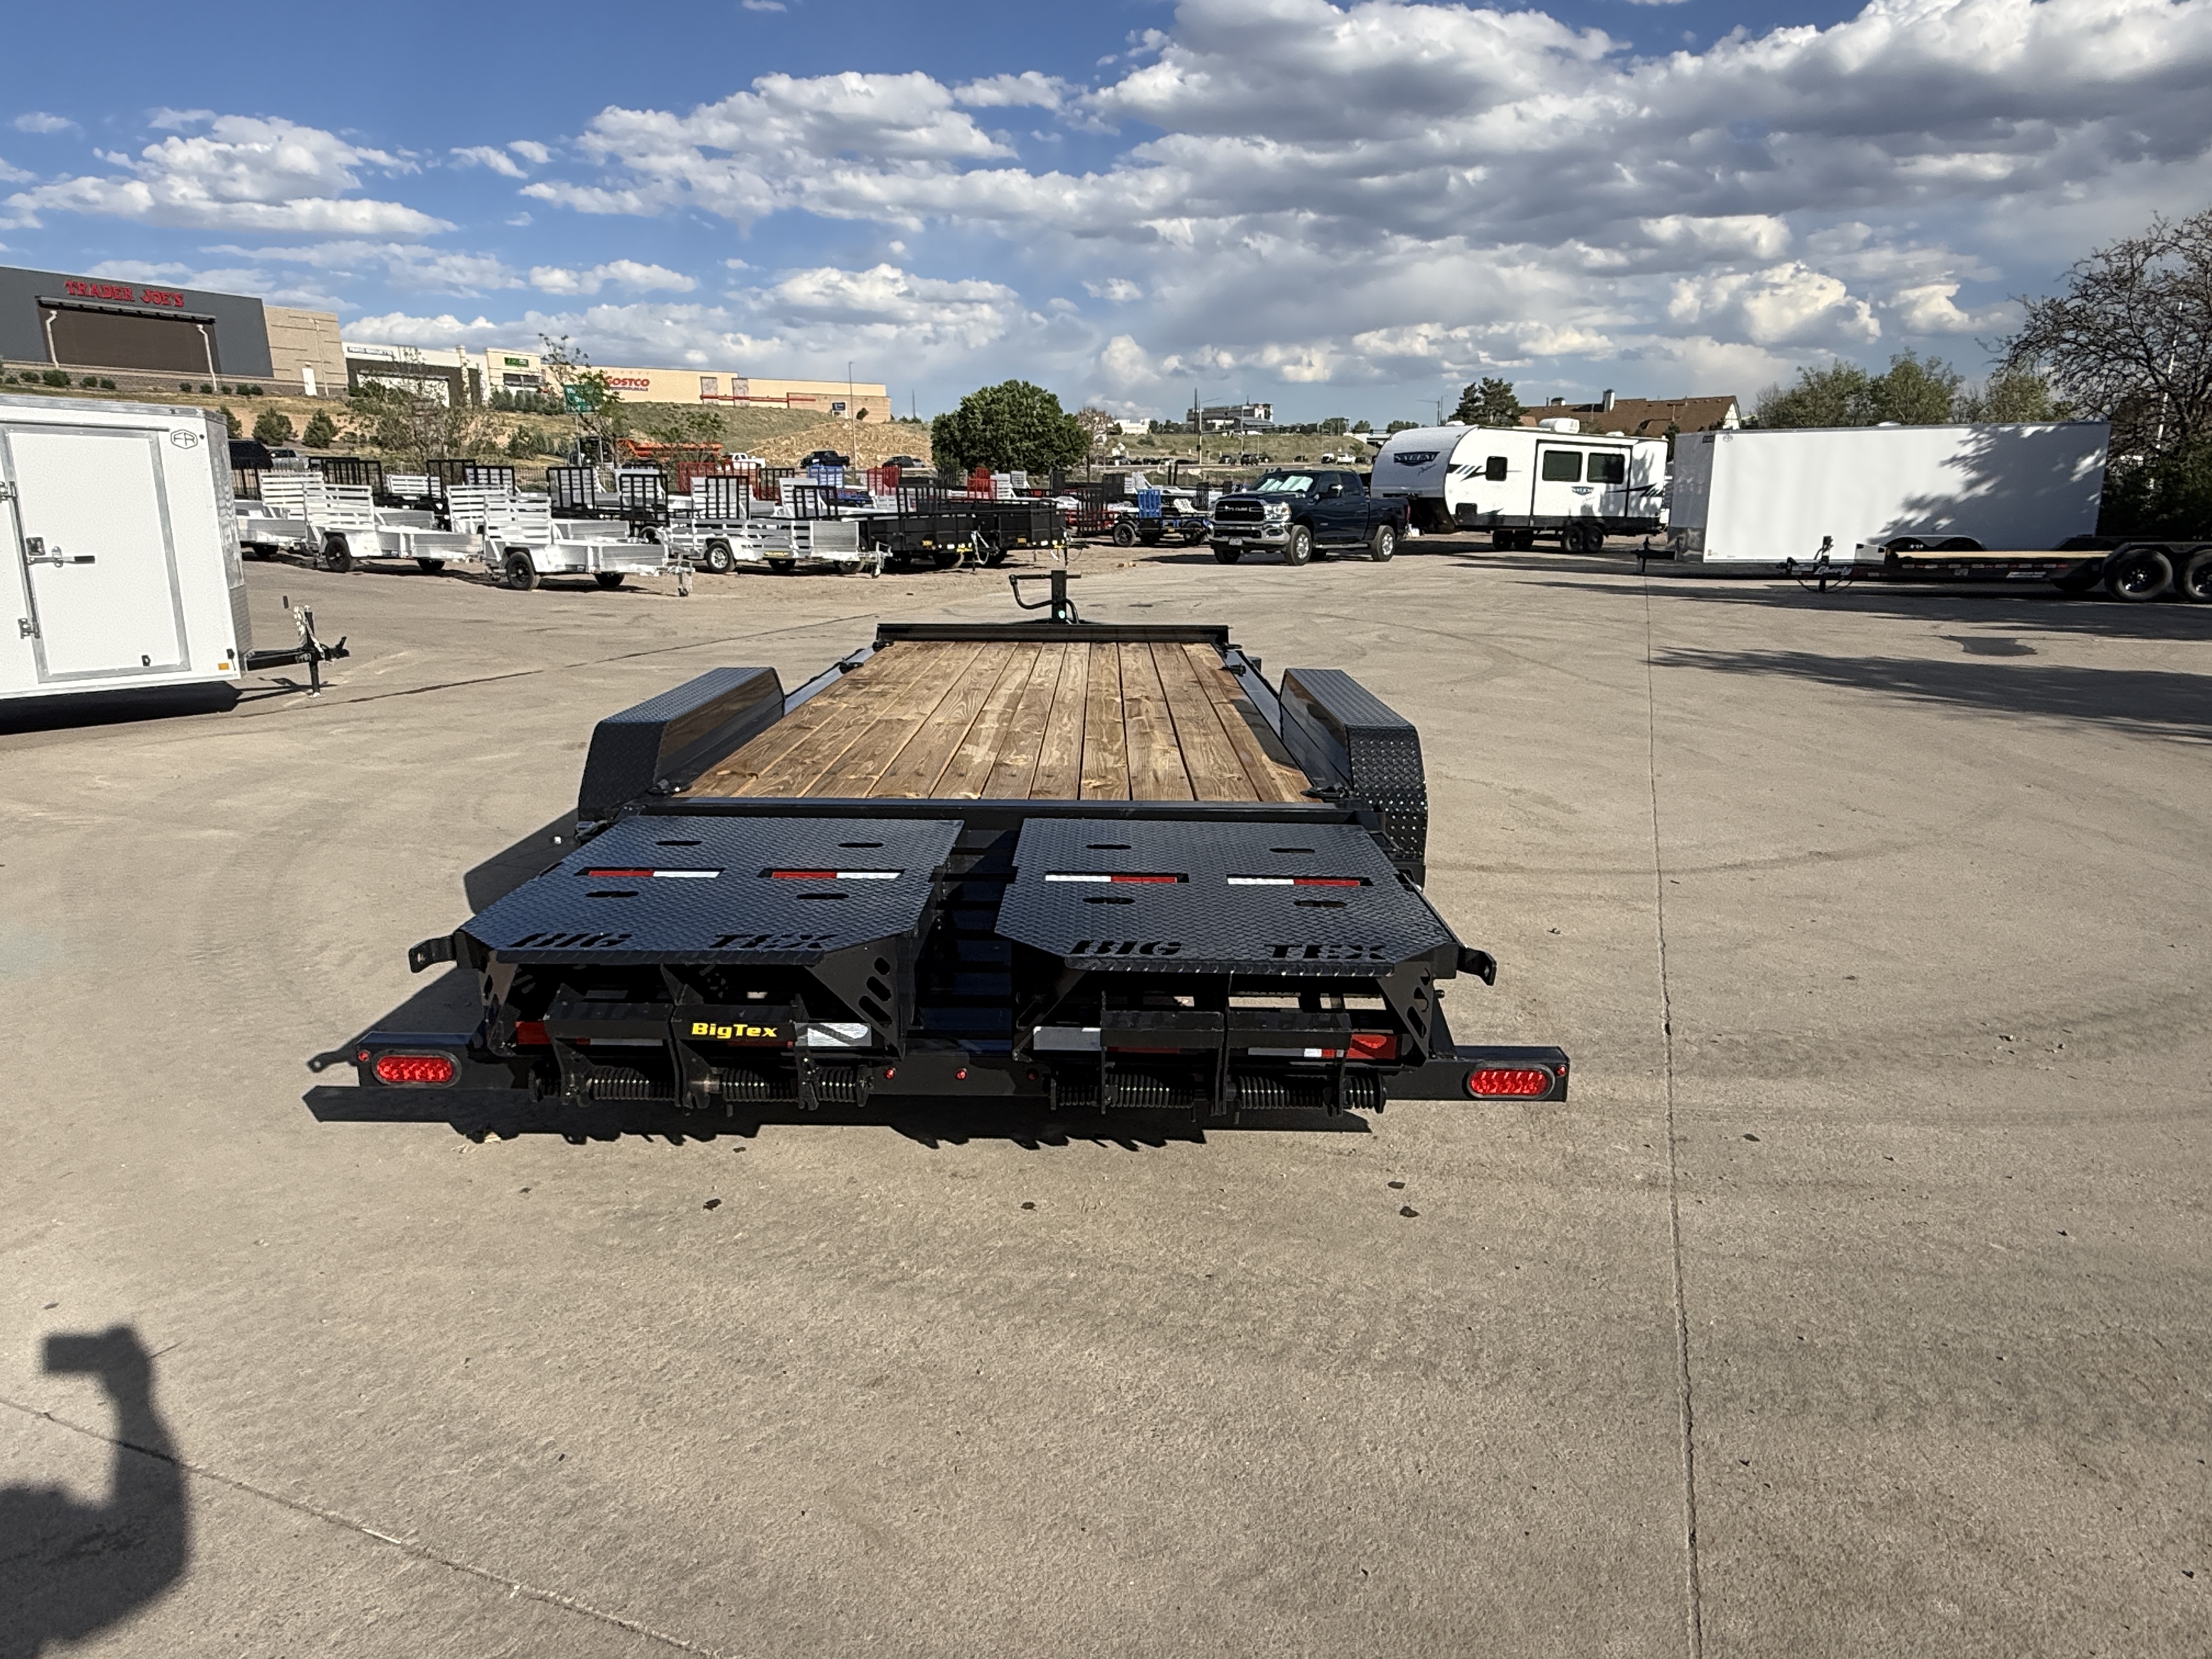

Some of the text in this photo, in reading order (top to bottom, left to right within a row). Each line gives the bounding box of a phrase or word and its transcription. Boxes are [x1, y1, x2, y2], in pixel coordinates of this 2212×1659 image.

[65, 280, 184, 307] TRADER JOE'S
[605, 376, 650, 387] COSTCO
[509, 933, 838, 949] BIG TEX
[1069, 940, 1386, 960] BIG TEX
[692, 1023, 778, 1039] BigTex
